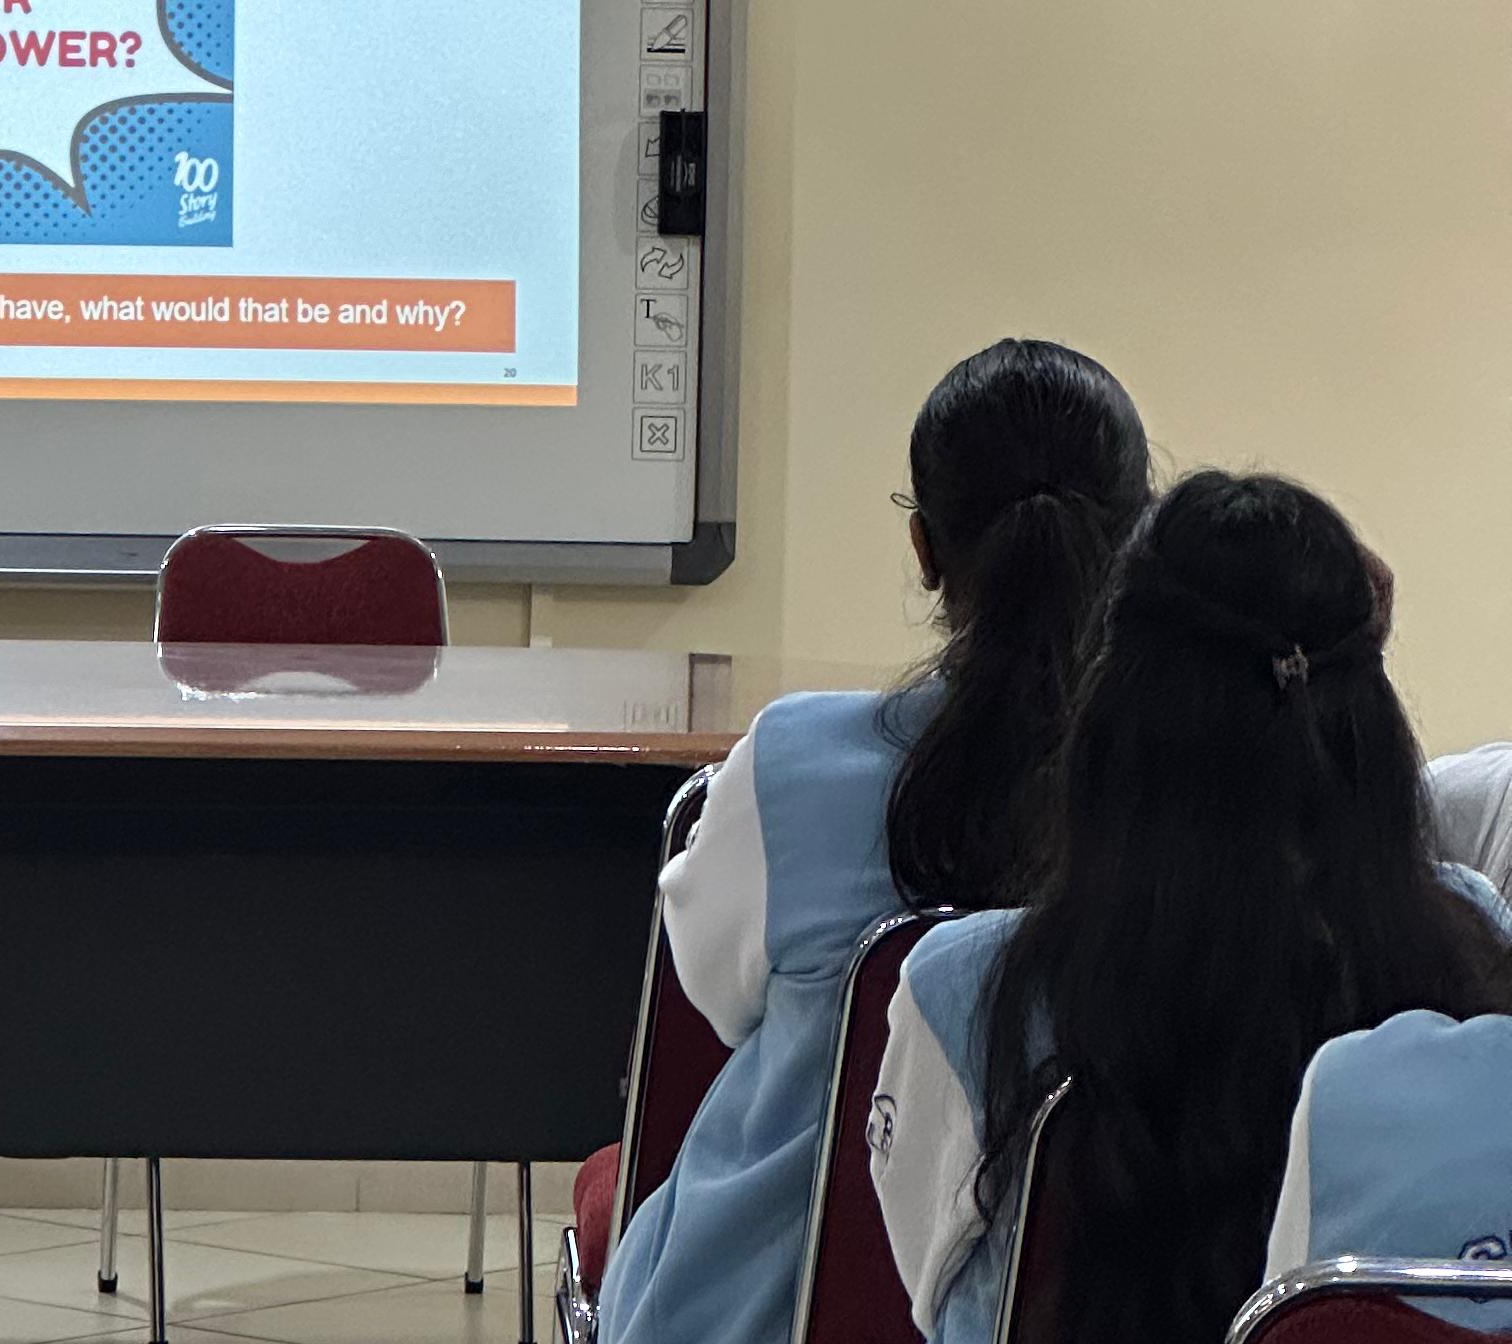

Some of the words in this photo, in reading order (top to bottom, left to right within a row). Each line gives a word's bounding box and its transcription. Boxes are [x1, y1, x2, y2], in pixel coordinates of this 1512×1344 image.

[173, 151, 219, 192] 100
[179, 192, 218, 215] Story
[79, 295, 144, 321] what
[151, 296, 230, 323] would
[238, 297, 289, 323] that
[296, 298, 330, 324] be
[338, 299, 388, 325] and
[395, 299, 466, 332] why?
[640, 363, 680, 392] K1
